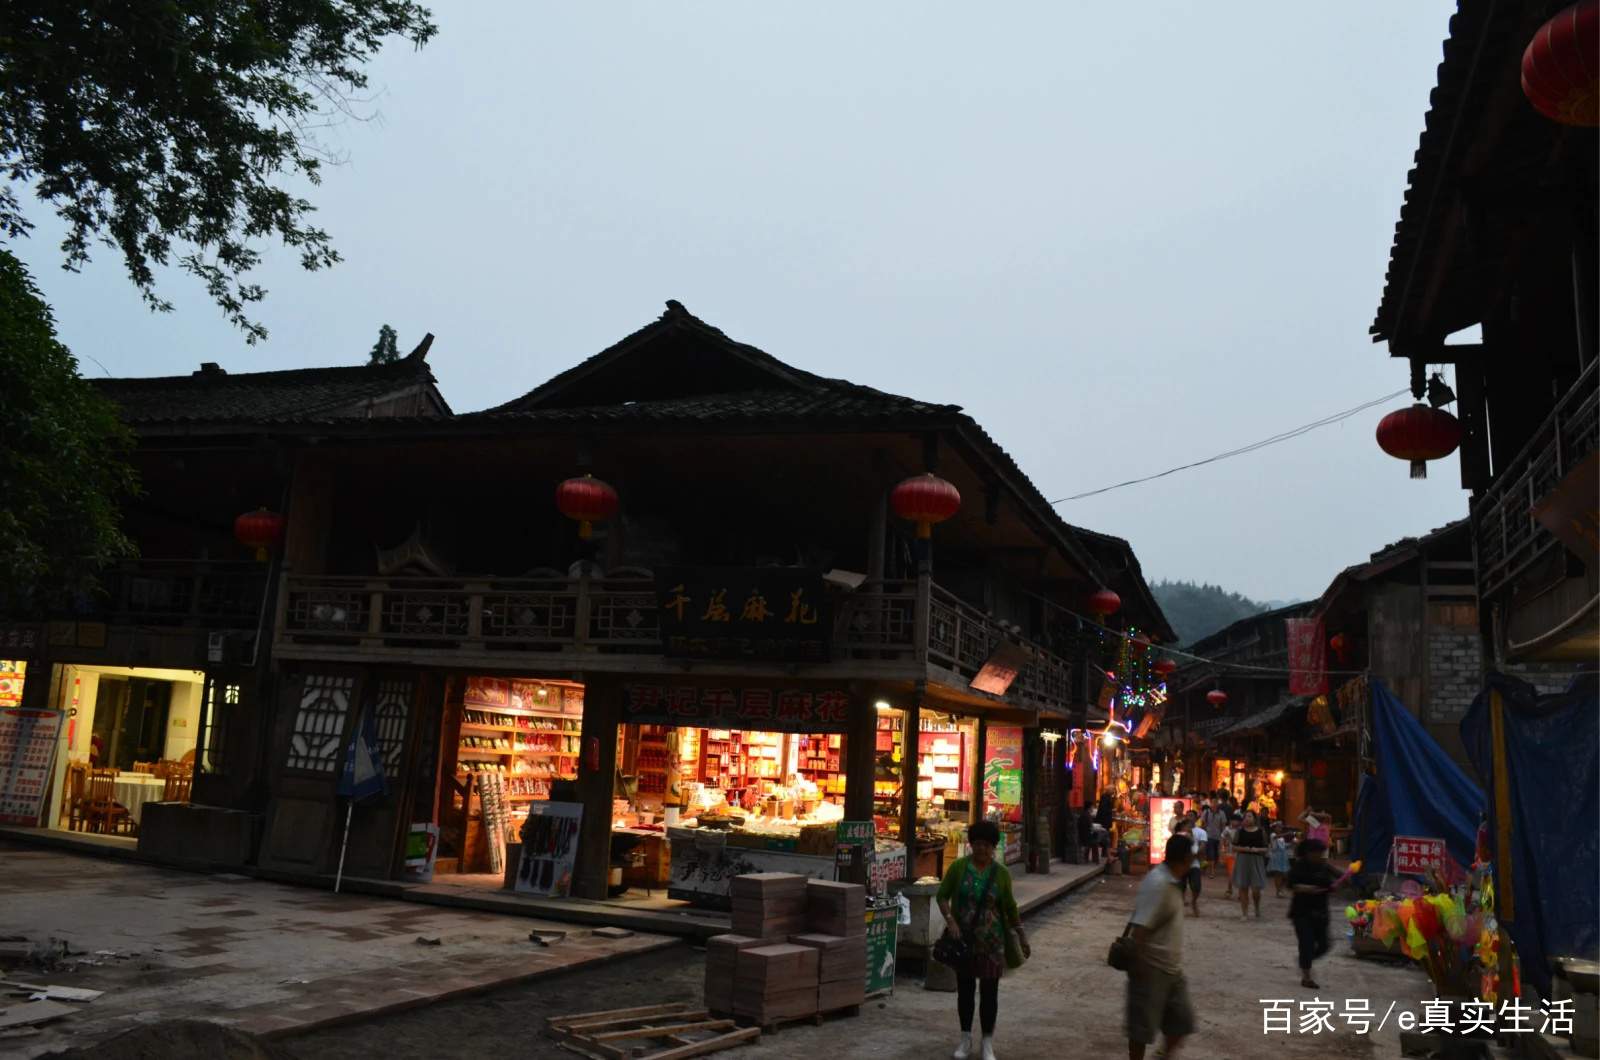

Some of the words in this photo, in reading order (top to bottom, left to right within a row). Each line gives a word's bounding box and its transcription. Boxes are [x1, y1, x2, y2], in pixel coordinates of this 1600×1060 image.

[628, 684, 852, 722] 尹记千层麻花
[1398, 842, 1442, 856] 施工重地
